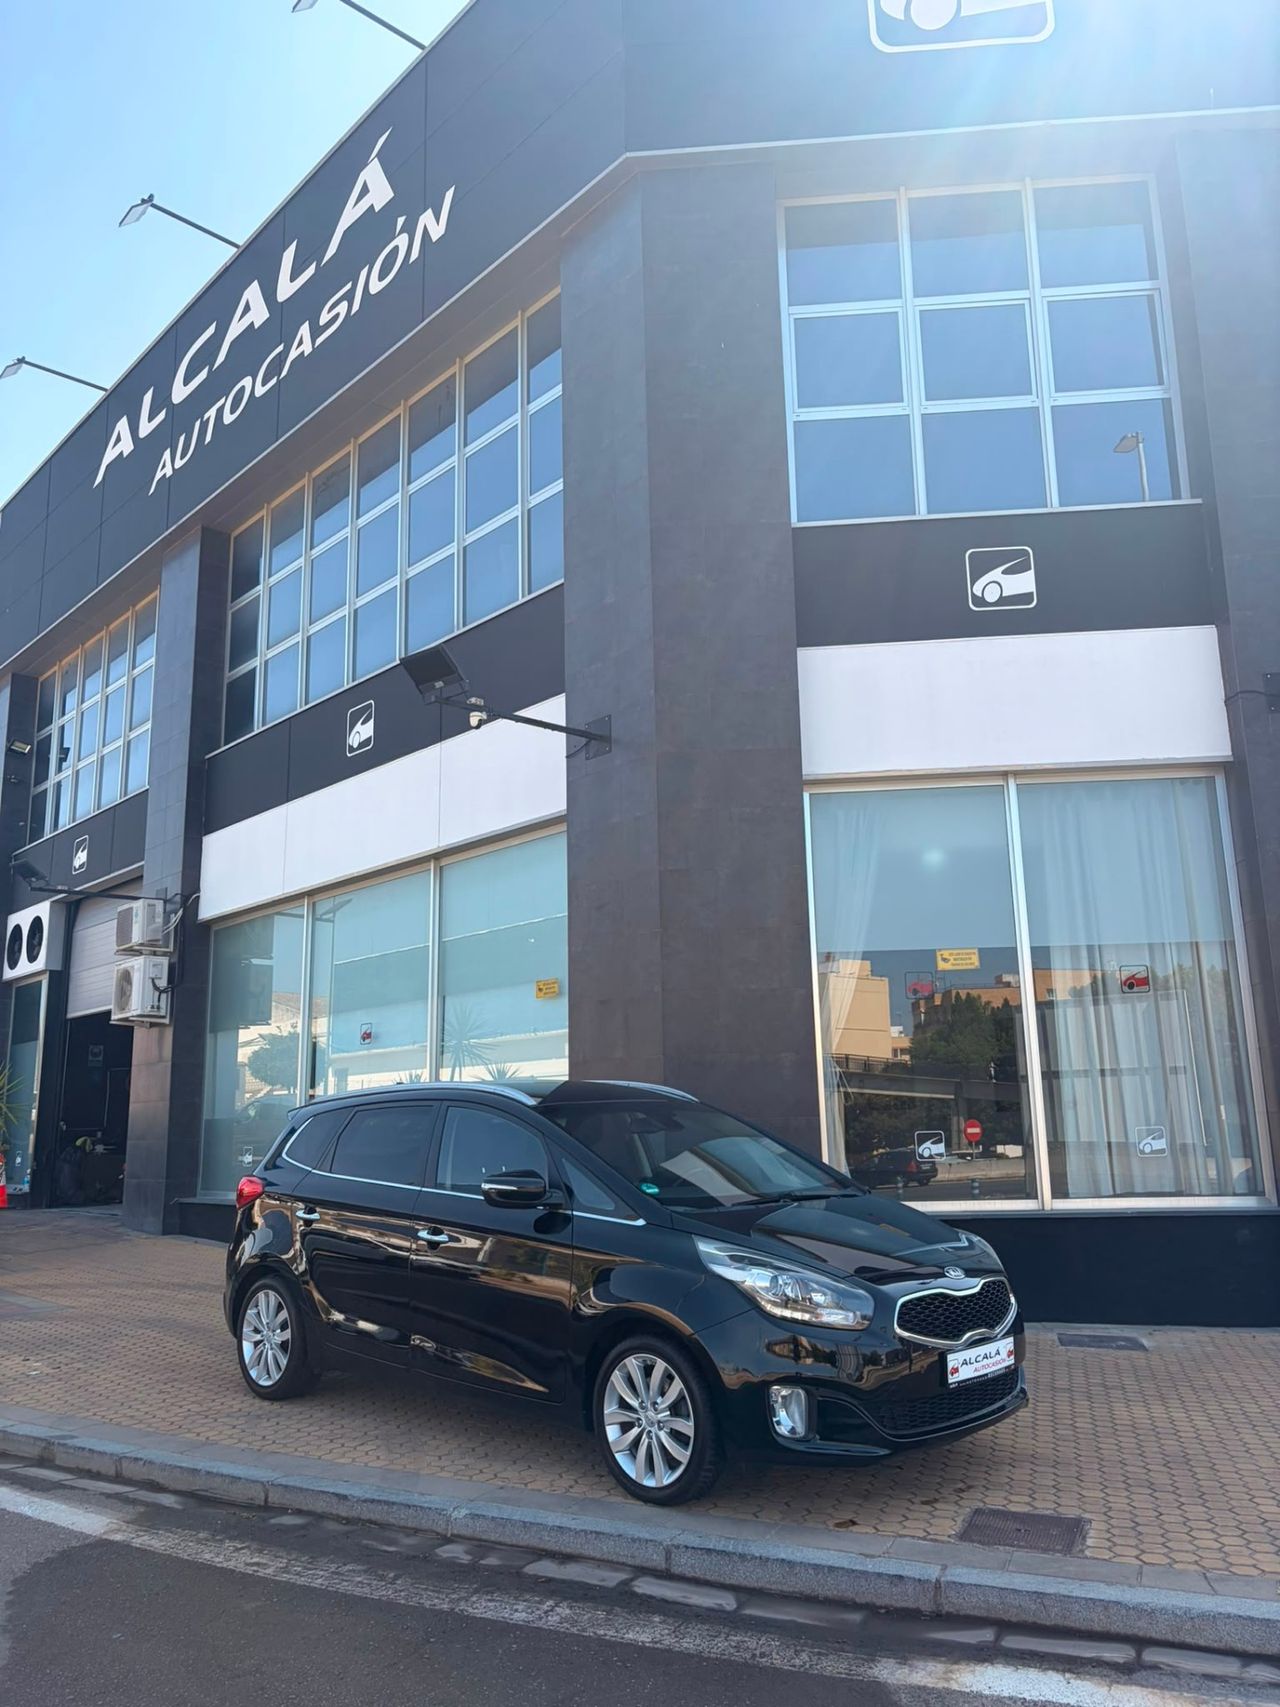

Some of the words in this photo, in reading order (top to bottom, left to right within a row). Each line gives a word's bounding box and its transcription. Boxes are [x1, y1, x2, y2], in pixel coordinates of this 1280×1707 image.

[93, 126, 395, 488] ALCALÁ
[148, 184, 456, 496] AUTOCASIÓN
[960, 1346, 1001, 1368] ALCALÁ
